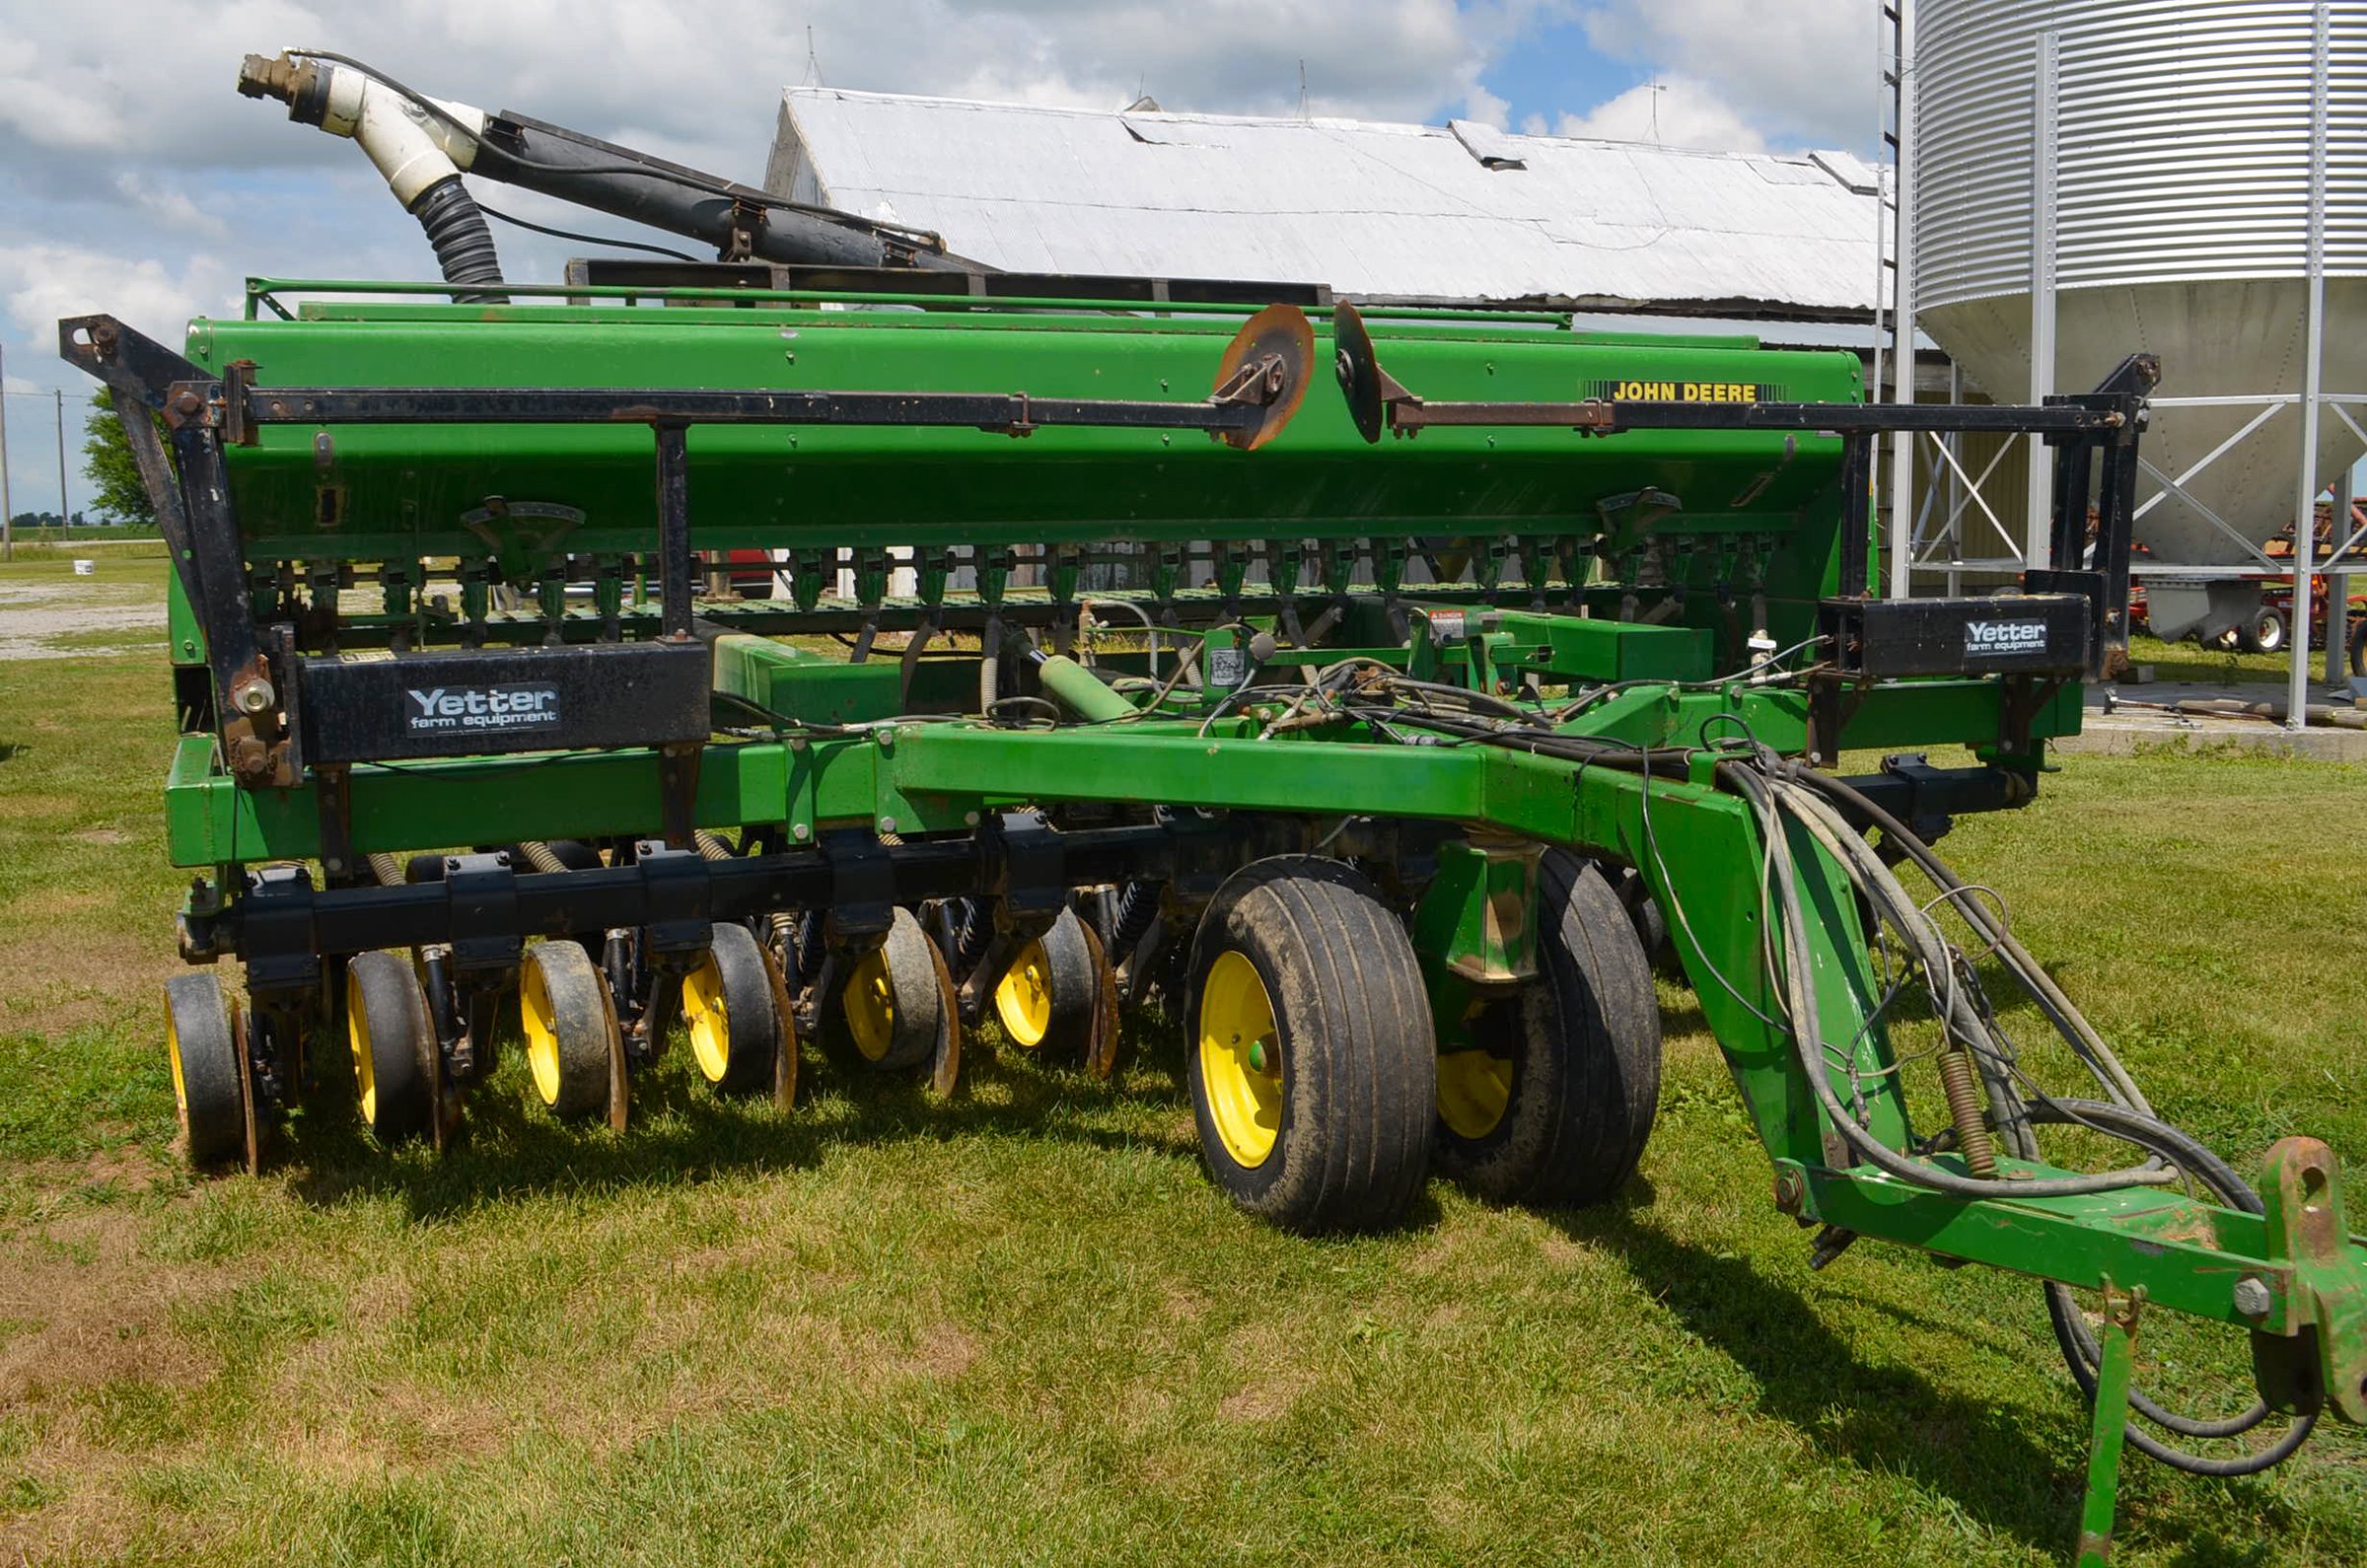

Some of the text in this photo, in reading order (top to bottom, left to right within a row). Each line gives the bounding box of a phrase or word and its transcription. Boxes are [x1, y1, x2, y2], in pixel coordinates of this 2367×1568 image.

[1614, 382, 1757, 401] JOHN DEERE
[1967, 622, 2045, 642] Yetter
[1967, 640, 2045, 651] farm equipment
[407, 689, 556, 716] Yetter
[410, 711, 556, 729] farm equipment
